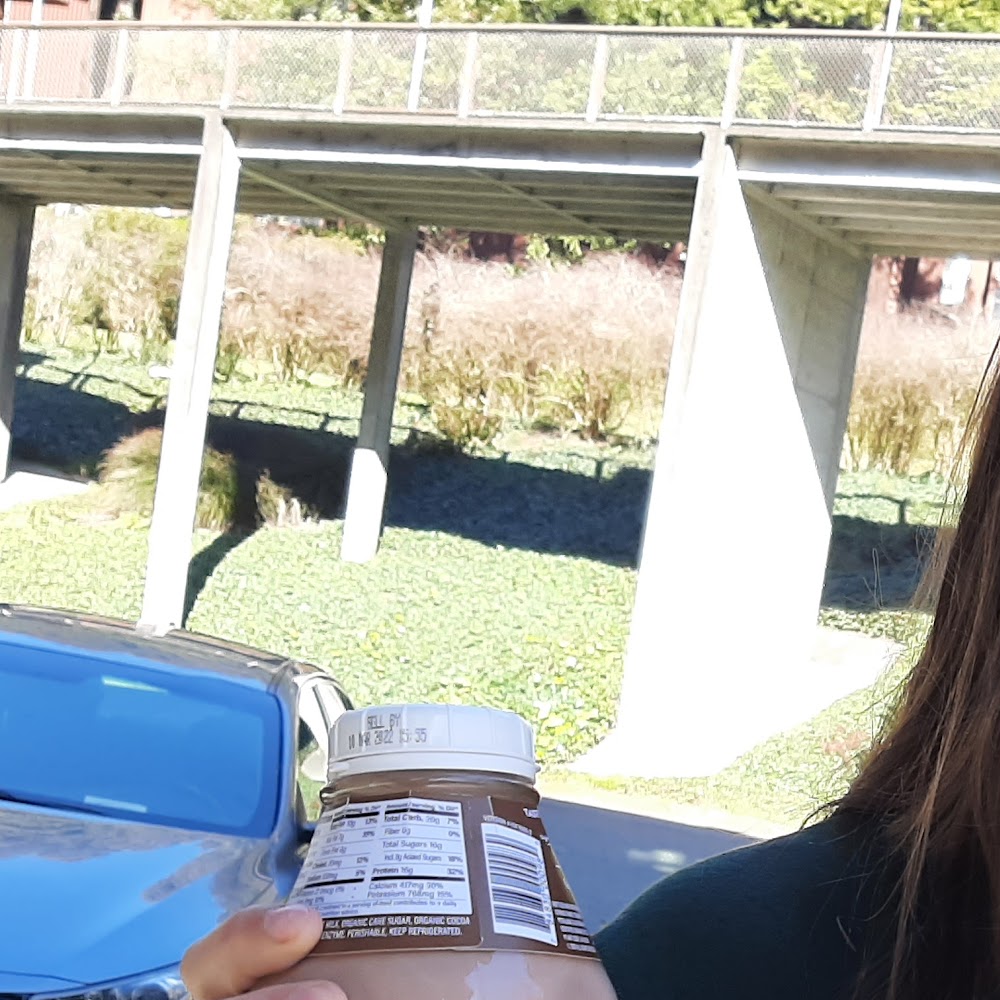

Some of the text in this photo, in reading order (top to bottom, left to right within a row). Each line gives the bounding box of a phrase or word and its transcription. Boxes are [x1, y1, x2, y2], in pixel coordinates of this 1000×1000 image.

[382, 840, 399, 849] Total
[400, 840, 427, 849] Sugars
[372, 866, 399, 875] Protein
[388, 926, 407, 936] KEEP
